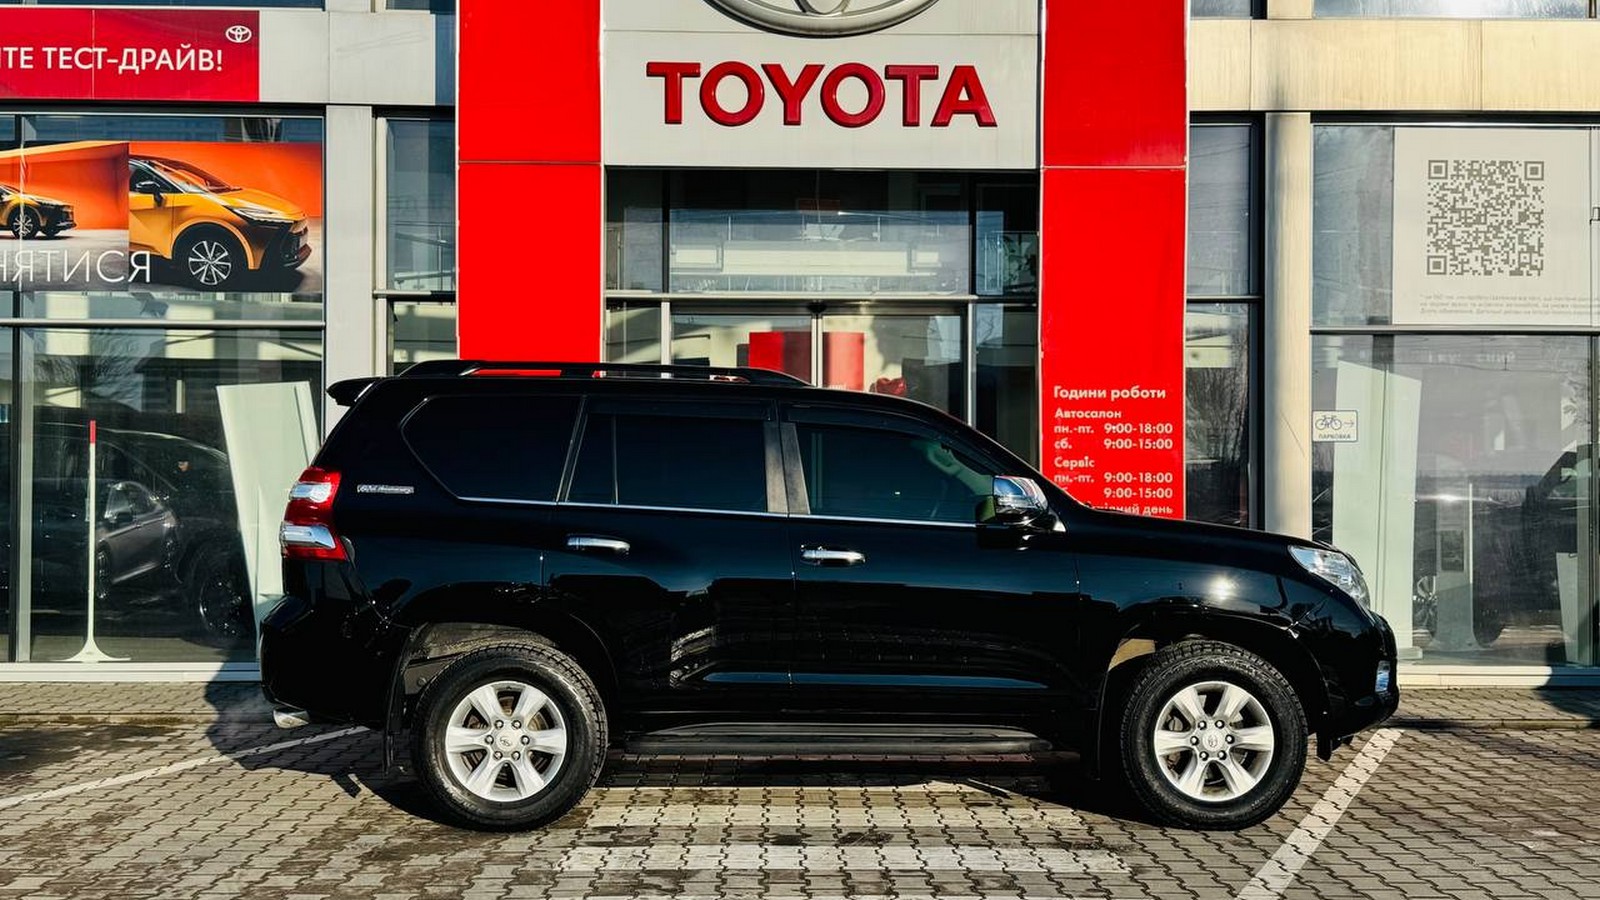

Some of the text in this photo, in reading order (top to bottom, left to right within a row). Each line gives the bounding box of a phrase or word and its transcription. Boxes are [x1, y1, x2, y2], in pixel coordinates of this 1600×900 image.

[0, 43, 223, 75] ТЕ ТЕСТ-ДРАЙВ!
[646, 61, 998, 128] TOYOTA
[1053, 385, 1166, 402] Години роботи
[1054, 407, 1122, 419] Автосалон
[1053, 422, 1173, 434] пн.-пт. 9:00-18:00
[1054, 437, 1173, 450] сб. 9:00-15:00
[1054, 456, 1096, 470] Сервіс
[1053, 472, 1173, 484] пн.-пт. 9:00-18:00
[1103, 487, 1173, 499] 9:00-15:00
[1143, 505, 1173, 517] день
